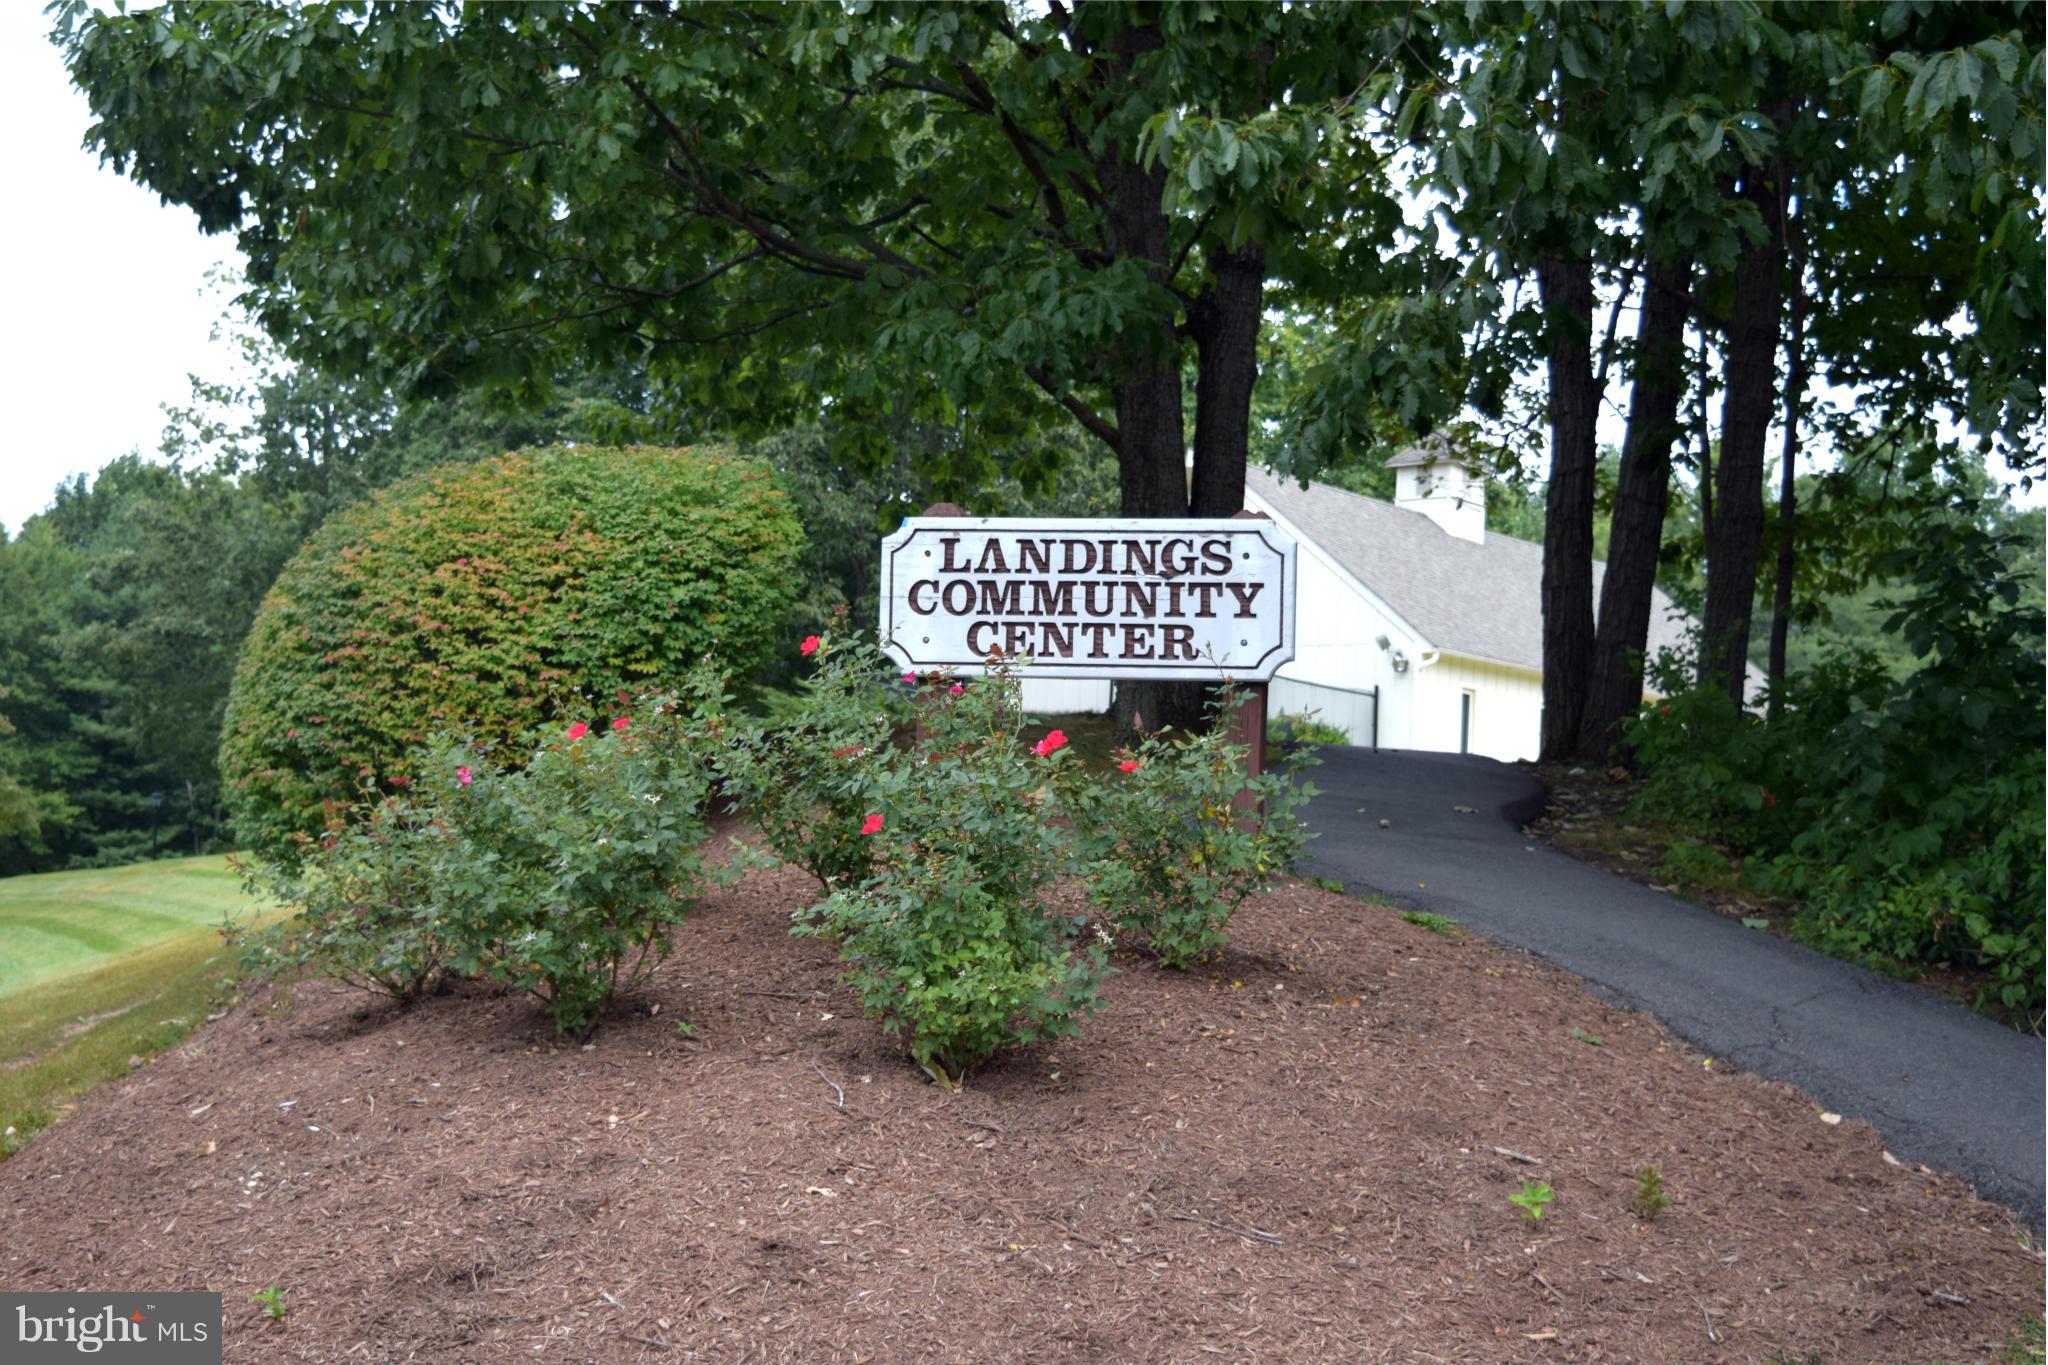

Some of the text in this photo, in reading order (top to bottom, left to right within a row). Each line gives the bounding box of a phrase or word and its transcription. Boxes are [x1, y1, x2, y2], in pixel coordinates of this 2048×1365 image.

[938, 537, 1233, 576] LANDINGS
[907, 579, 1265, 619] COMMUNITY
[966, 620, 1201, 660] CENTER
